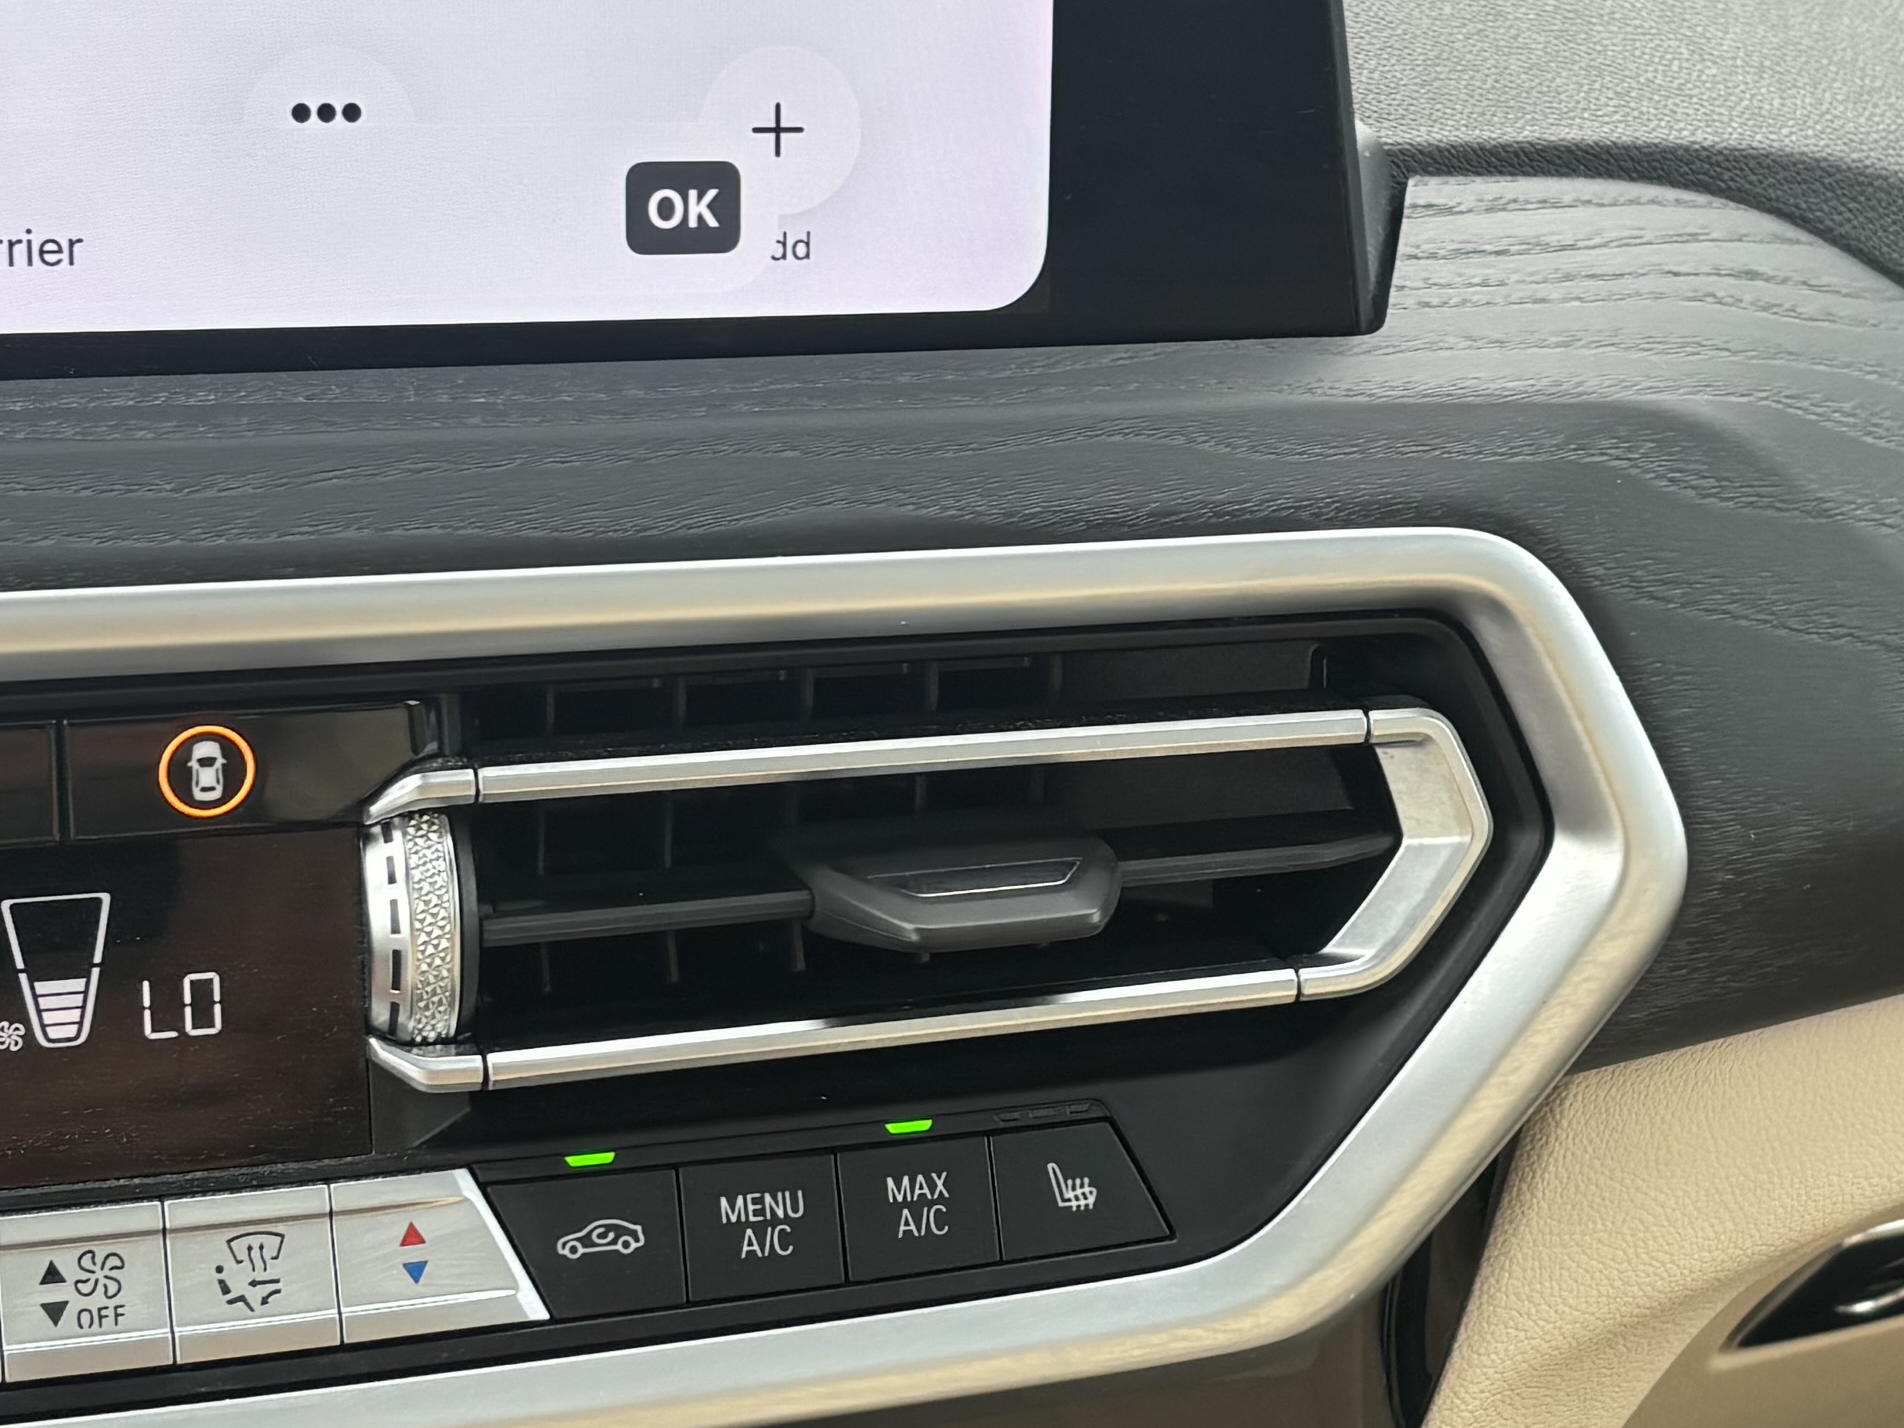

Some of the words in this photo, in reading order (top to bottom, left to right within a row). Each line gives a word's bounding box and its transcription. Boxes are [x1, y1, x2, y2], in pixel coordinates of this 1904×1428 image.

[647, 188, 720, 230] OK
[770, 230, 811, 262] dd
[142, 971, 222, 1040] LO
[886, 1171, 950, 1205] MAX
[719, 1190, 804, 1224] MENU
[898, 1204, 949, 1239] A/C
[741, 1224, 794, 1259] A/C
[76, 1304, 126, 1330] OFF
